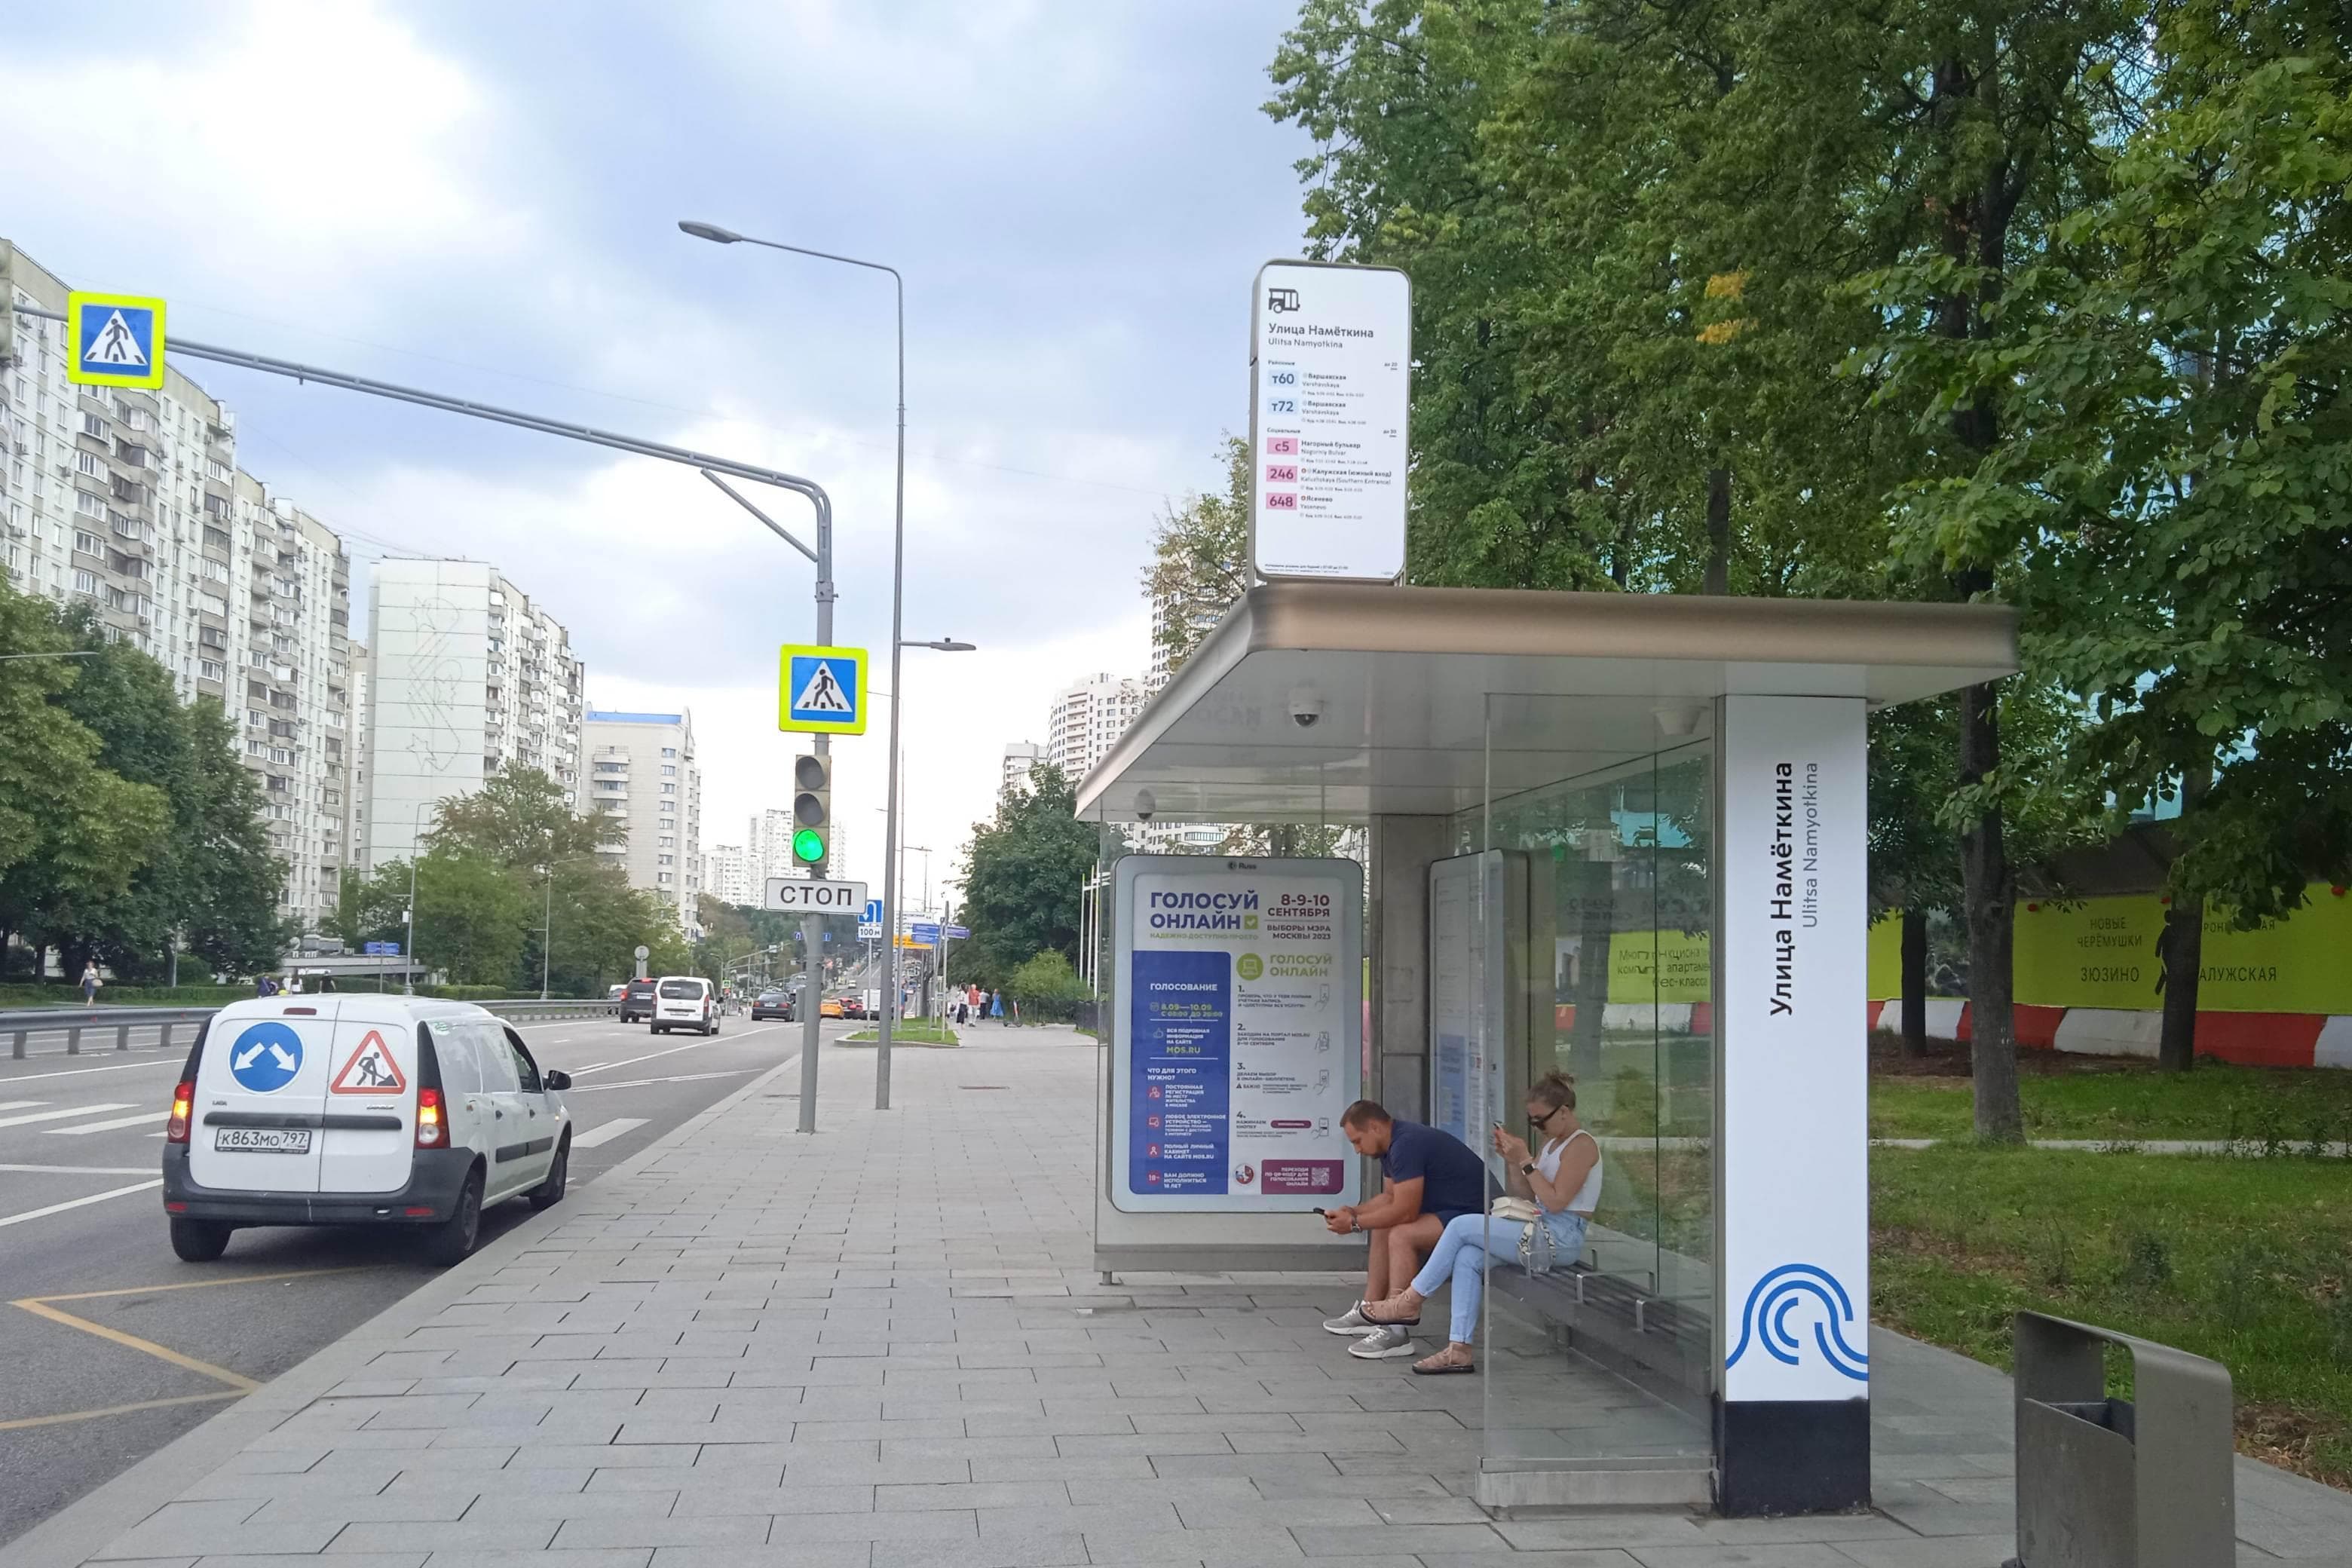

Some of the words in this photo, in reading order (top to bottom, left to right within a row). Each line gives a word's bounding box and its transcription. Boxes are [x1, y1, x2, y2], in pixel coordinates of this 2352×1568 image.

[1269, 323, 1305, 335] Улица
[1309, 325, 1374, 338] Намёткина
[1268, 338, 1292, 346] Ulitsa
[1294, 338, 1343, 348] Namyotkina
[1272, 373, 1294, 384] т60
[1308, 372, 1346, 381] Варшавская
[1272, 401, 1294, 412] т72
[1270, 468, 1294, 479] 246
[1269, 496, 1293, 507] 648
[1802, 763, 1821, 871] Namyotkina
[1770, 763, 1792, 919] Намёткина
[780, 886, 852, 905] СТОП
[1150, 890, 1258, 910] ГОЛОСУЙ
[1282, 894, 1330, 906] 8-9-10
[1802, 878, 1818, 927] Ulitsa
[1268, 908, 1330, 917] СЕНТЯБРЯ
[1150, 911, 1240, 929] ОНЛАЙН
[2090, 917, 2127, 929] НОВЫЕ
[1270, 953, 1332, 965] ГОЛОСУЙ
[1270, 965, 1328, 977] ОНЛАЙН
[1770, 929, 1795, 1015] Улица
[2081, 966, 2139, 982] ЗЮЗИНО
[2199, 966, 2277, 982] АЛУЖСКАЯ
[1150, 983, 1218, 991] ГОЛОСОВАНИЕ
